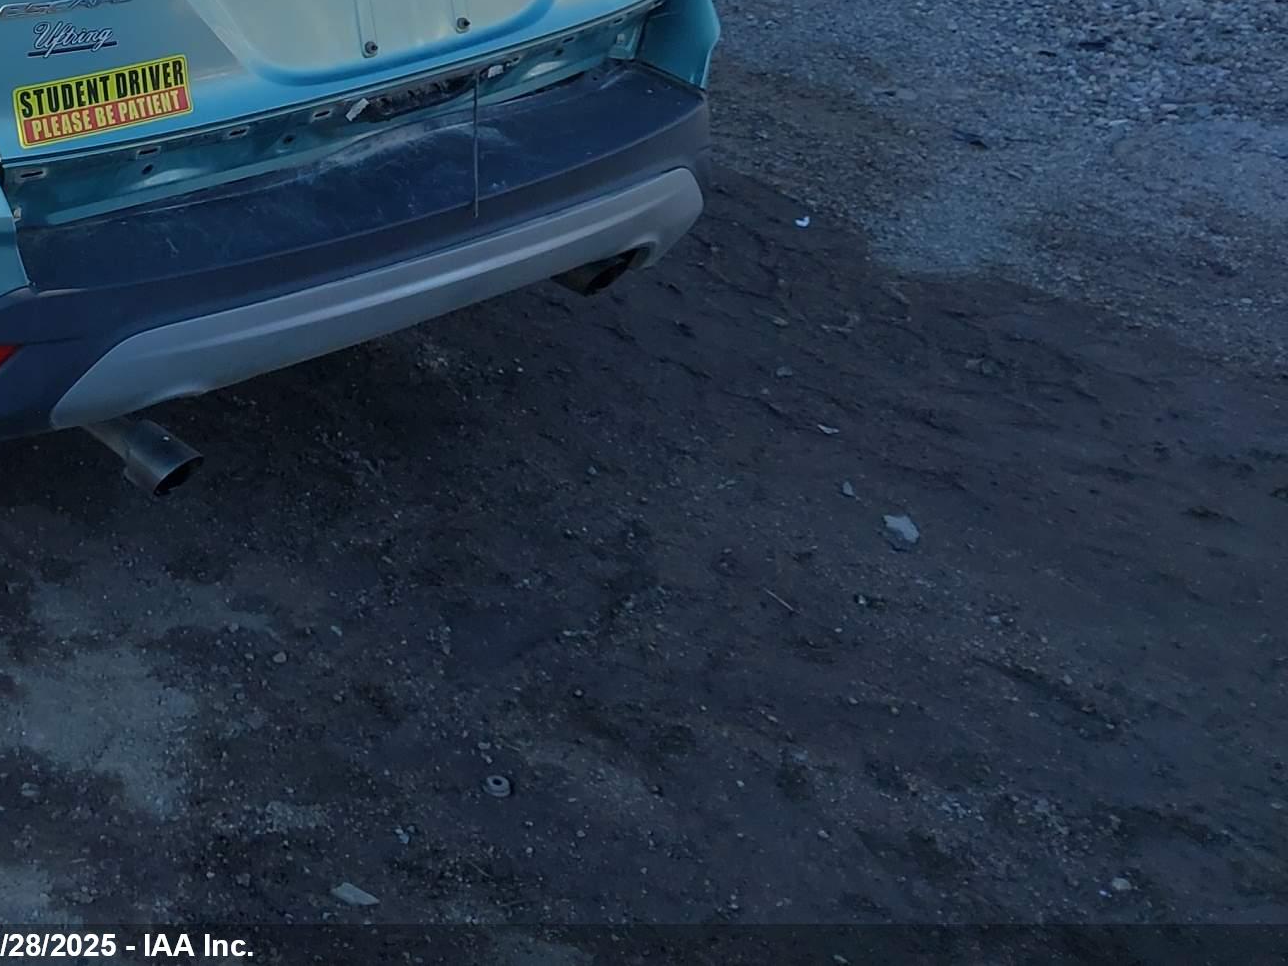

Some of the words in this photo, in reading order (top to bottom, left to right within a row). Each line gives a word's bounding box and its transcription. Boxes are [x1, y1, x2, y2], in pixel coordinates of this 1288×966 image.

[33, 21, 112, 57] Uftring
[19, 75, 112, 118] STUDENT
[114, 59, 185, 100] DRIVER
[31, 110, 93, 141] PLEASE
[96, 103, 116, 127] BE
[117, 90, 181, 123] PATIENT
